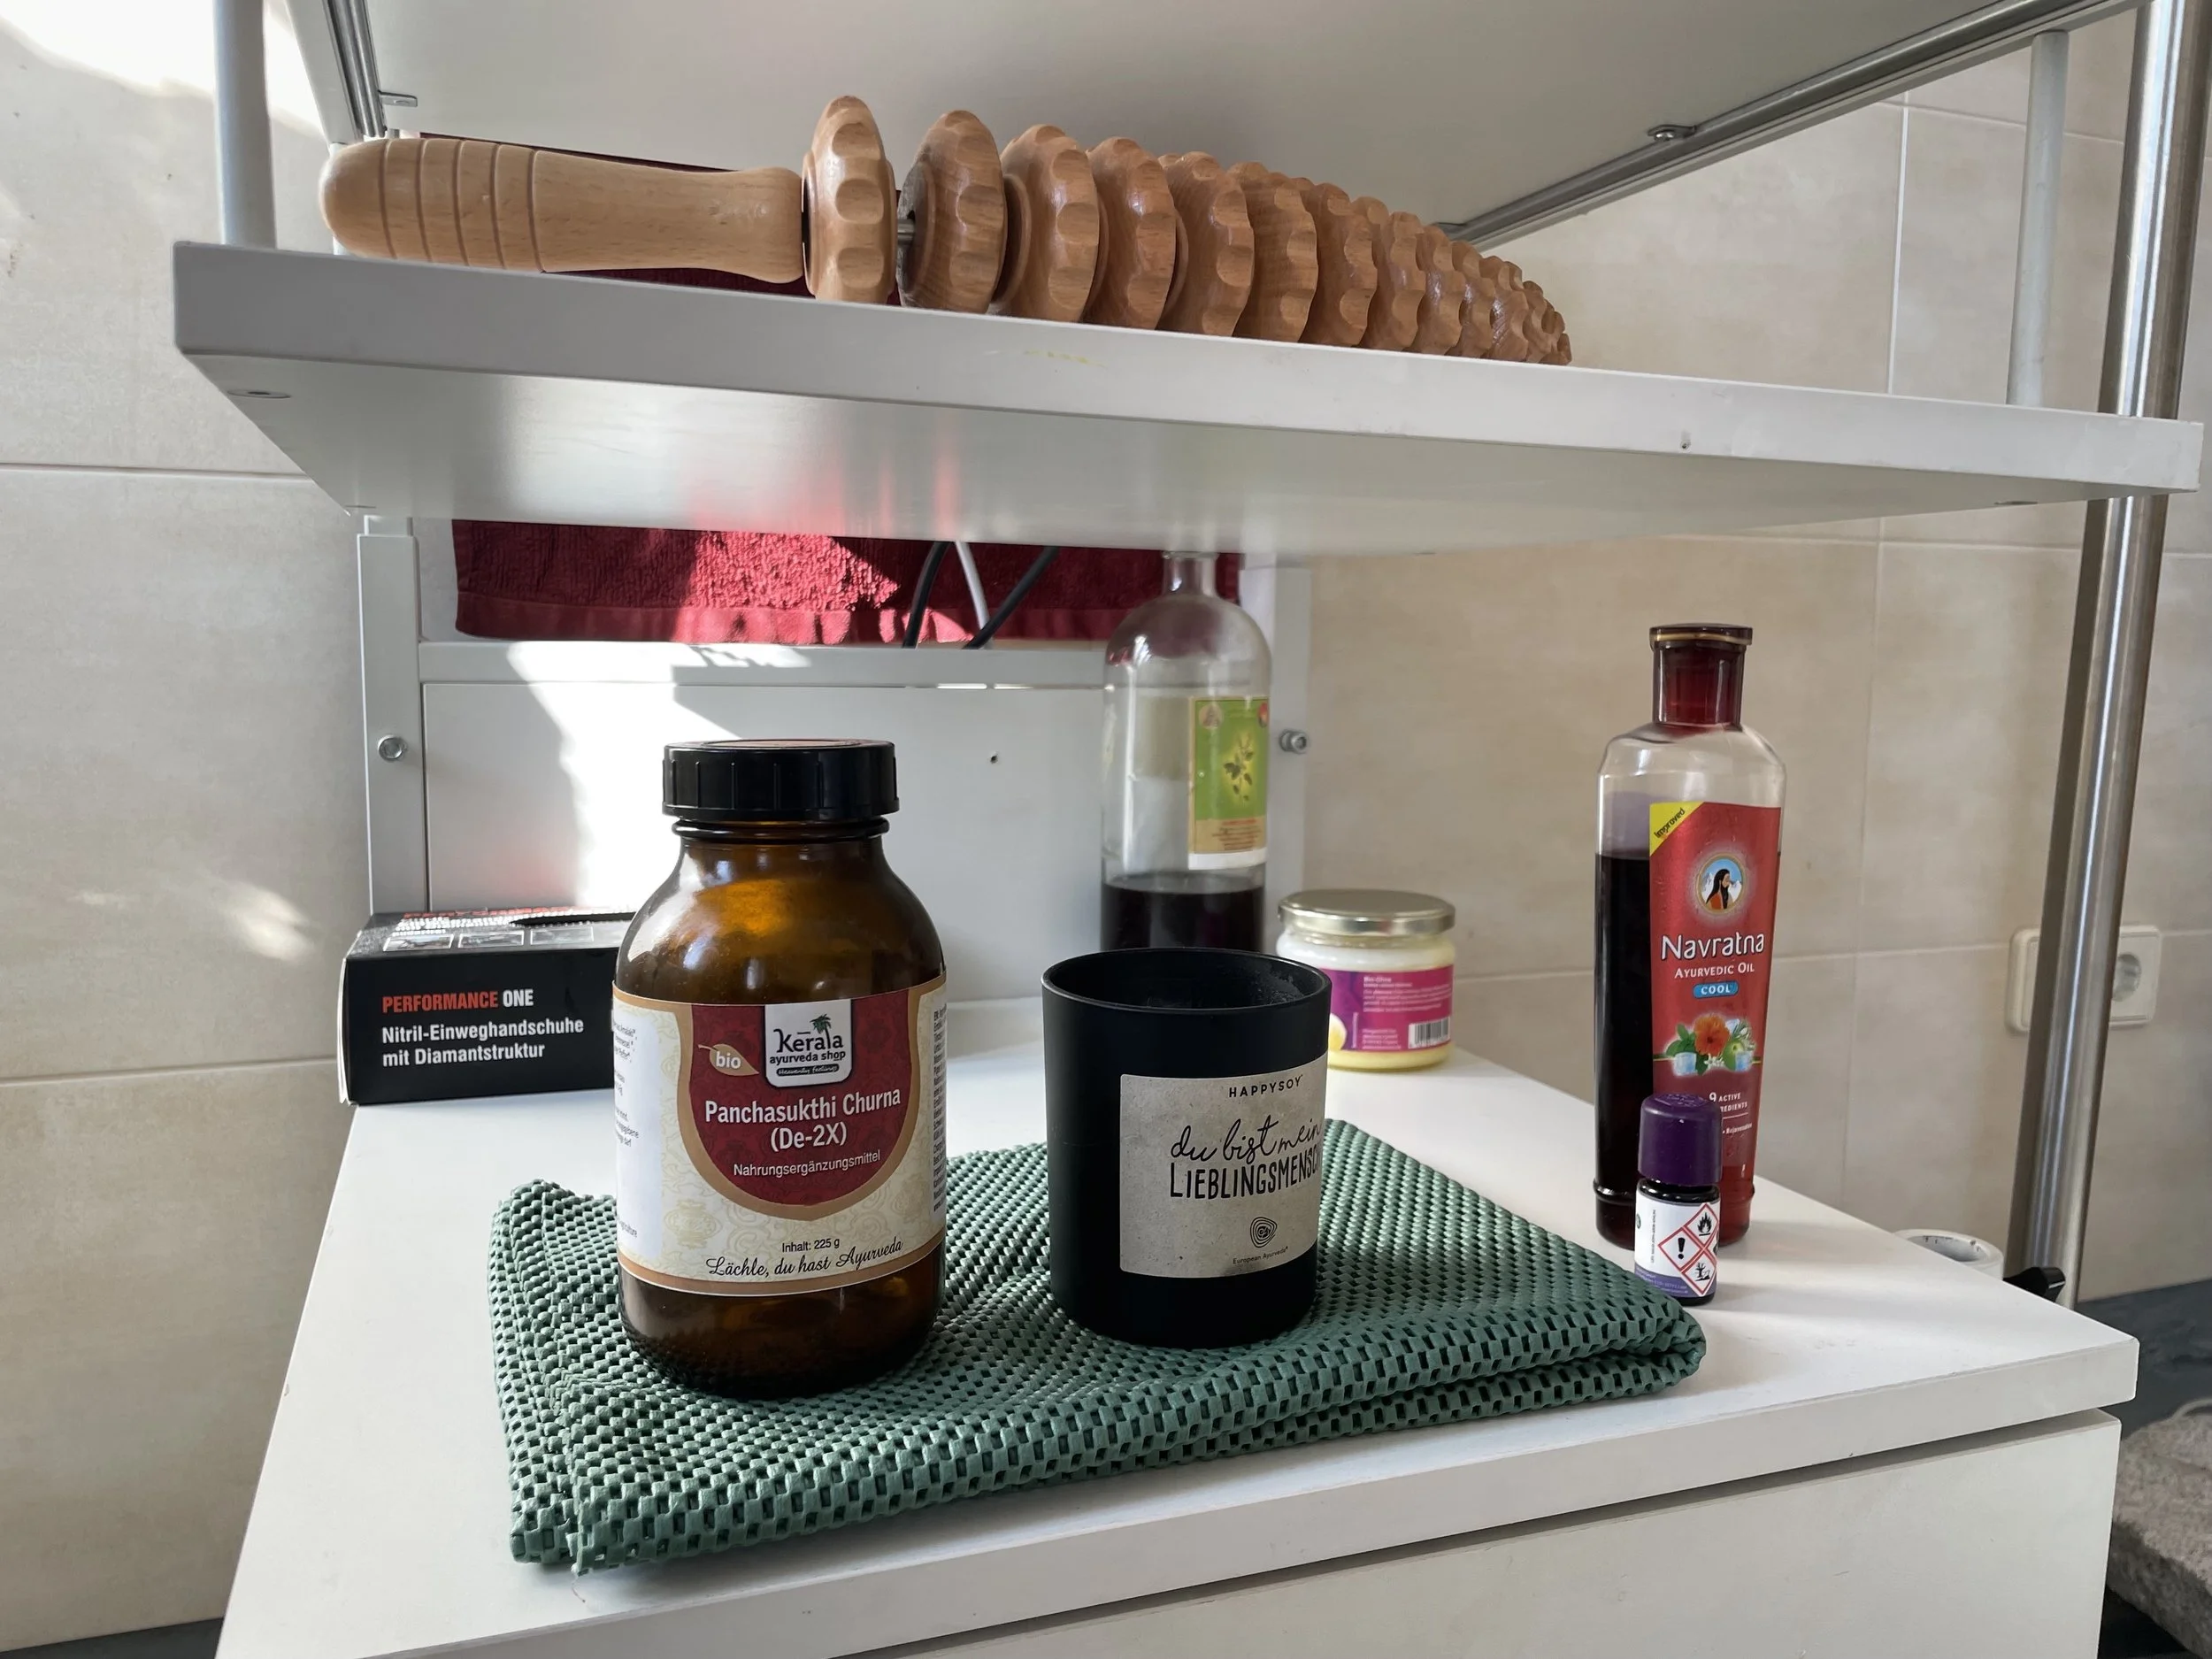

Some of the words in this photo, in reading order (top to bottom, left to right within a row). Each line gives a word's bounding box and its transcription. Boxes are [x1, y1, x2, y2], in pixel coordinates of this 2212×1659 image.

[1654, 807, 1686, 839] Improved
[1661, 932, 1765, 961] Navratna
[1674, 964, 1734, 979] AYURVEDIC
[1738, 962, 1755, 973] OIL
[382, 991, 498, 1013] PERFORMANCE
[503, 989, 534, 1008] ONE
[1701, 983, 1732, 995] COOL
[382, 1018, 584, 1044] Nitril-Einweghandschuhe
[382, 1048, 410, 1067] mit
[414, 1042, 545, 1065] Diamantstruktur
[716, 1051, 741, 1069] bio
[769, 1052, 818, 1065] ayurveda
[821, 1051, 846, 1062] shop
[1228, 1075, 1302, 1098] HAPPYSOY
[1709, 1092, 1717, 1102] 9
[1718, 1092, 1741, 1102] ACTIVE
[705, 1097, 837, 1123] Panchasukthi
[842, 1088, 901, 1115] Churna
[1719, 1102, 1748, 1113] EDIENTS
[770, 1122, 847, 1152] (De-2X)
[1171, 1125, 1217, 1162] du
[1222, 1115, 1279, 1164] bist
[733, 1149, 881, 1178] Nahrungsergänzungsmittel
[1170, 1144, 1320, 1200] LIEBLINGSMENSC
[705, 1256, 770, 1278] Lächle,
[774, 1261, 795, 1275] du
[798, 1258, 832, 1274] hast
[835, 1236, 903, 1270] Ayurveda
[781, 1240, 811, 1253] Inhalt:
[814, 1239, 832, 1249] 225
[833, 1238, 840, 1249] g
